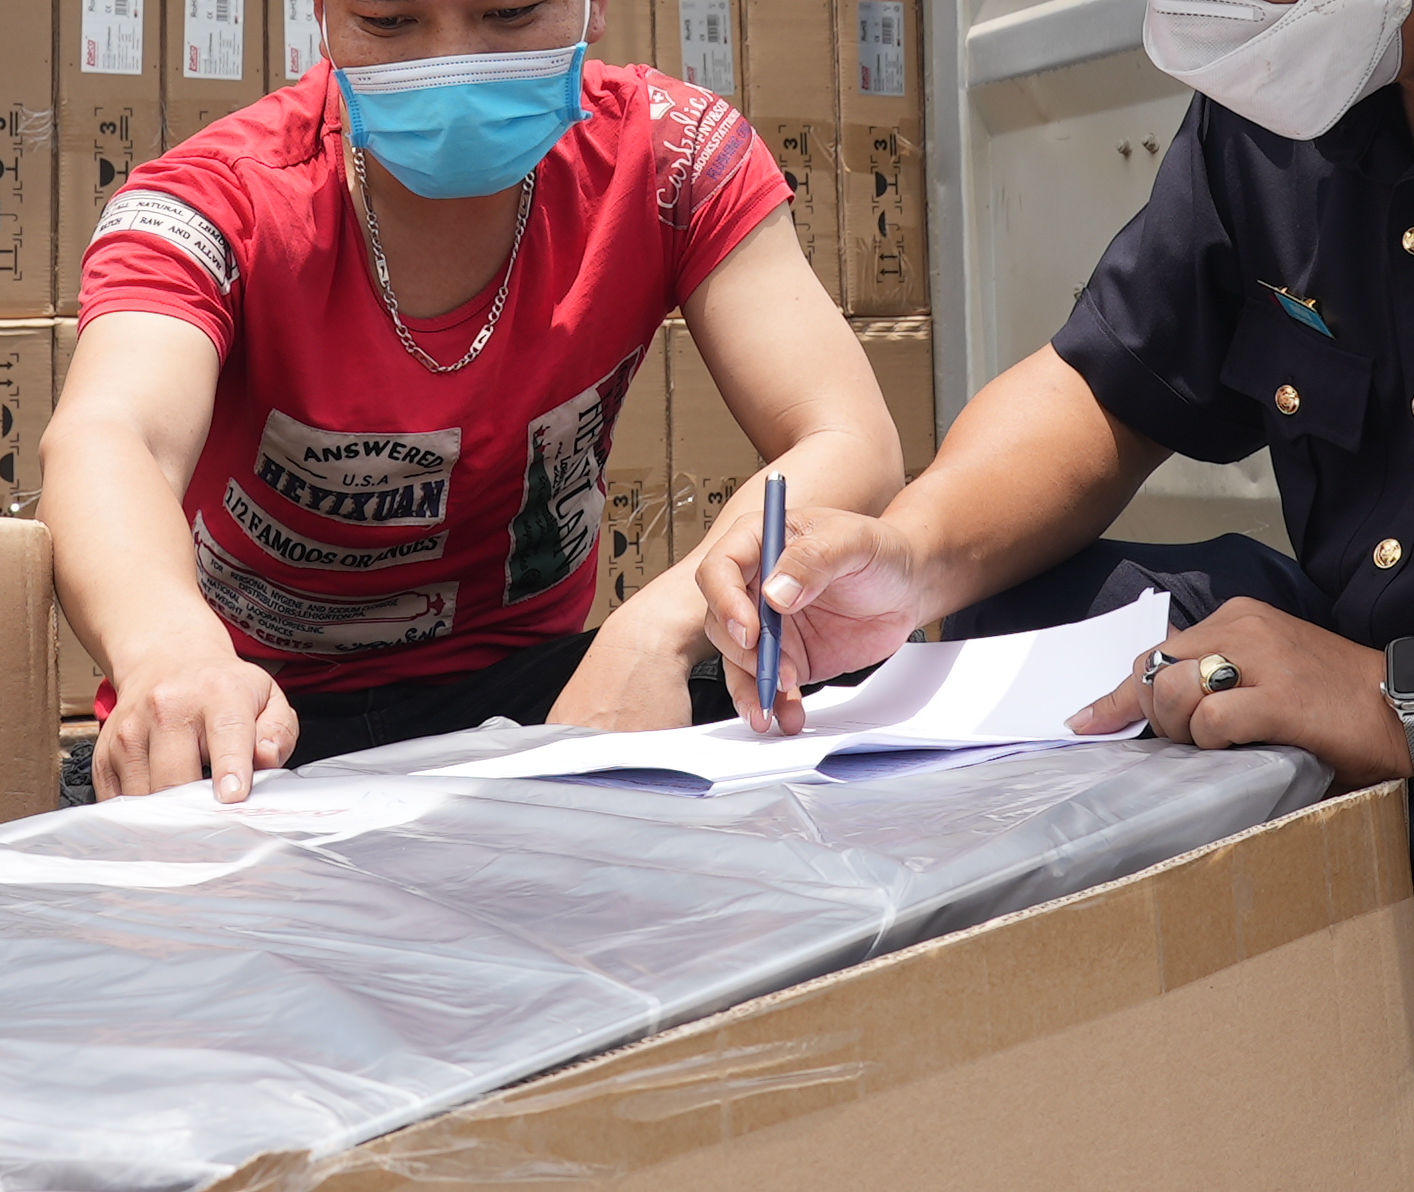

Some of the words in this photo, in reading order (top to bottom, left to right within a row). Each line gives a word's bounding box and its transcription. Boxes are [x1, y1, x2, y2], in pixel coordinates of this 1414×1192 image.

[136, 201, 184, 216] NATURAL
[139, 217, 163, 227] RAW
[168, 225, 190, 240] AND
[303, 440, 444, 469] ANSWERED
[342, 473, 389, 487] U.S.A
[258, 618, 295, 637] OUNCES
